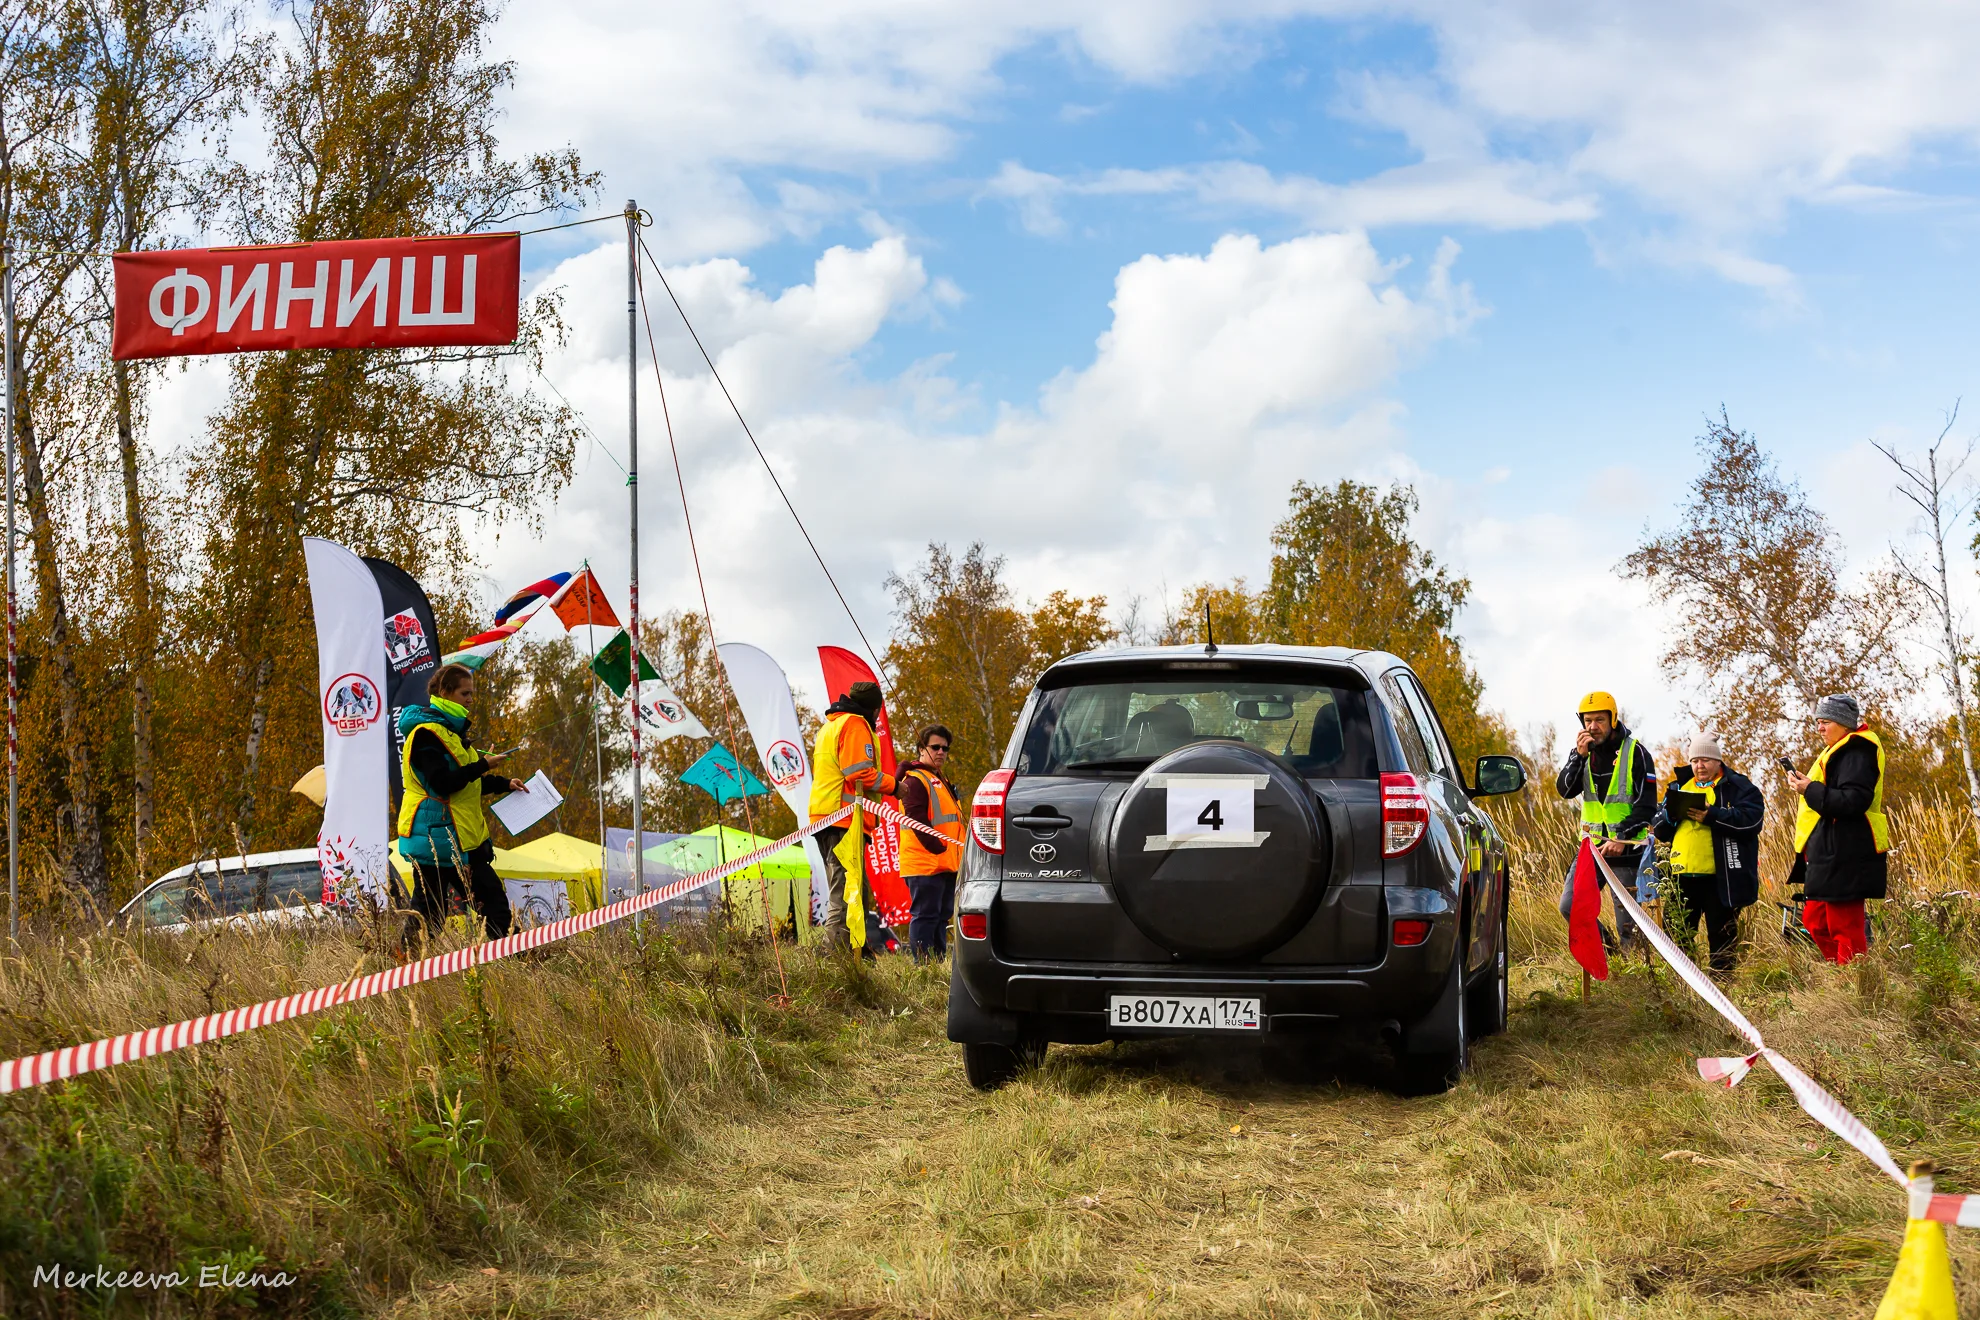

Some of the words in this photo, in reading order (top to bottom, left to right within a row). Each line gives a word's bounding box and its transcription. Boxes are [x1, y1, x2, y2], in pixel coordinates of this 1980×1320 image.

[148, 254, 477, 336] ФИНИШ
[1197, 799, 1224, 831] 4
[1037, 869, 1082, 879] RAV4
[1118, 999, 1212, 1025] В807ХА
[1218, 1000, 1253, 1019] 174
[1225, 1019, 1243, 1027] RUS
